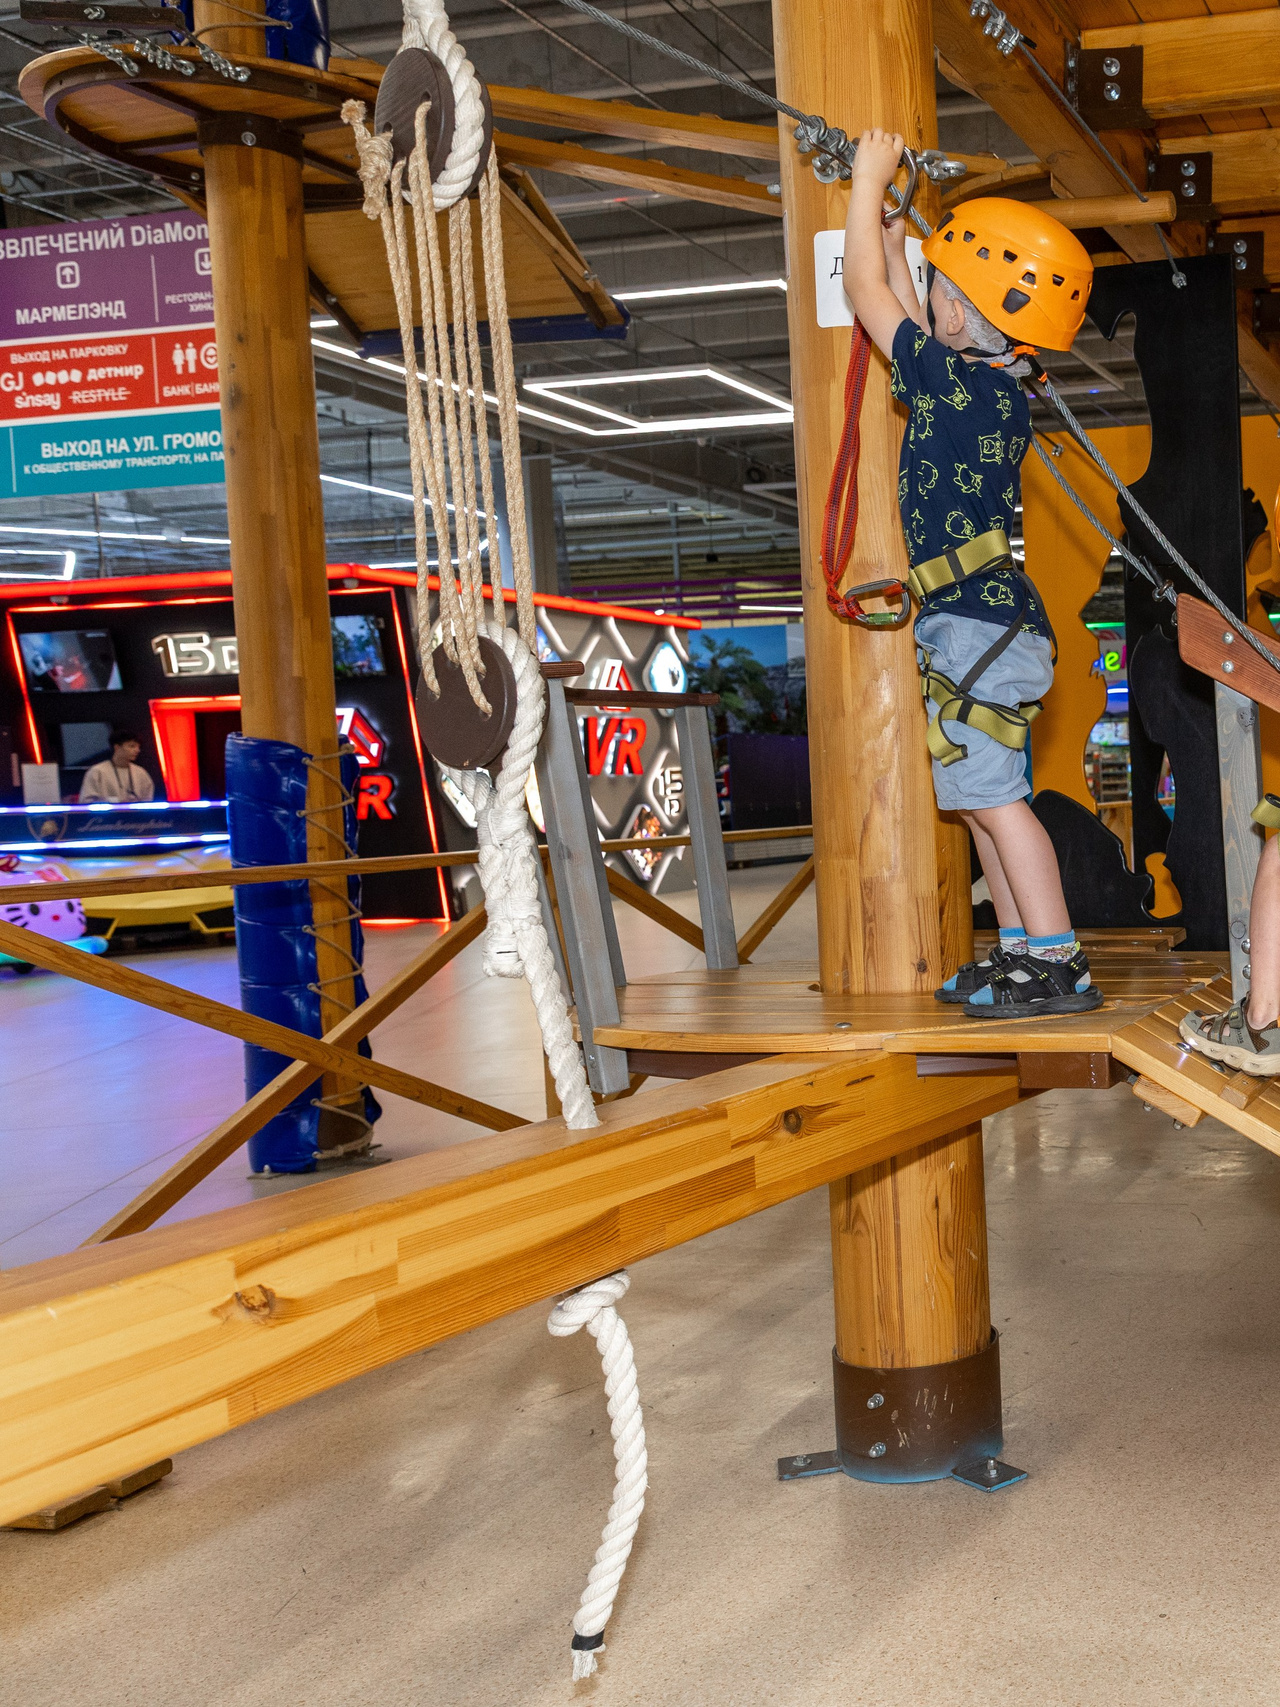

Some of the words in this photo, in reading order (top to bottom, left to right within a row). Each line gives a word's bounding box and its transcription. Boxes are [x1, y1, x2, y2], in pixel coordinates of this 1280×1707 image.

[16, 300, 126, 325] МАРМЕЛЭНД
[10, 350, 51, 364] ВЫХОД
[51, 348, 68, 360] НА
[69, 343, 128, 359] ПАРКОВКУ
[0, 371, 24, 392] GJ
[14, 391, 61, 410] sinsay
[41, 438, 102, 458] ВЫХОД
[106, 436, 130, 454] НА
[133, 435, 159, 453] УЛ.
[163, 430, 223, 449] ГРОМО
[24, 464, 31, 474] К
[32, 458, 123, 474] ОБЩЕСТВЕННОМУ
[125, 453, 193, 469] ТРАНСПОРТУ,
[194, 453, 209, 463] НА
[583, 715, 647, 776] VR
